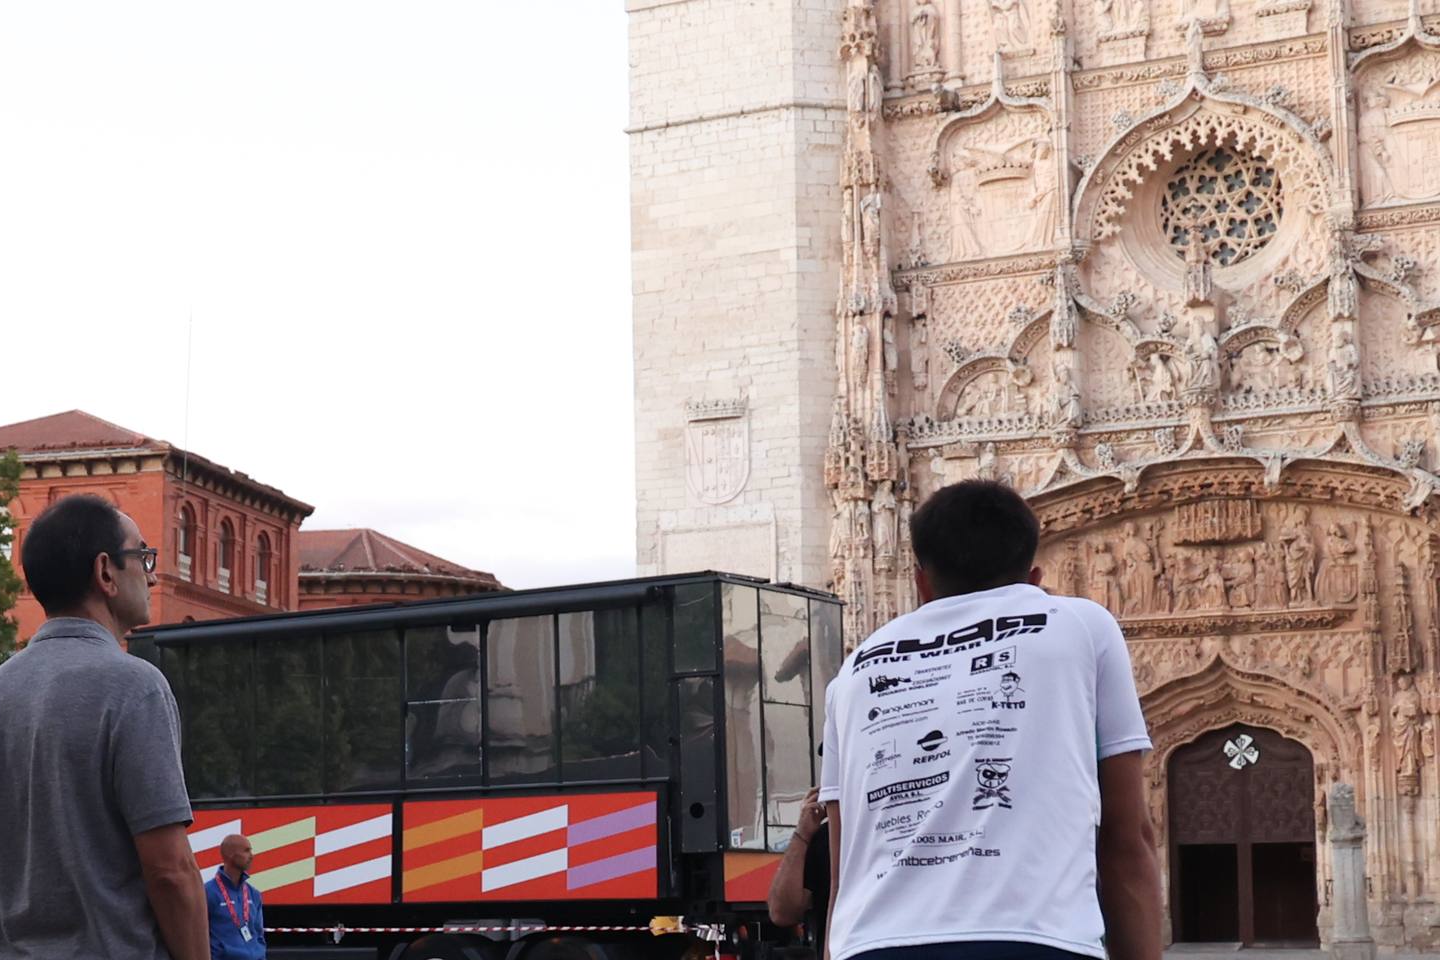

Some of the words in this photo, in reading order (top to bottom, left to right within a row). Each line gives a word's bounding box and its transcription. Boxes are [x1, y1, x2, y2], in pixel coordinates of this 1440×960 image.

[852, 655, 912, 676] ACTIVE
[920, 641, 981, 659] WEAR
[913, 749, 951, 765] REPSOL
[869, 773, 948, 801] MULTISERVICIOS
